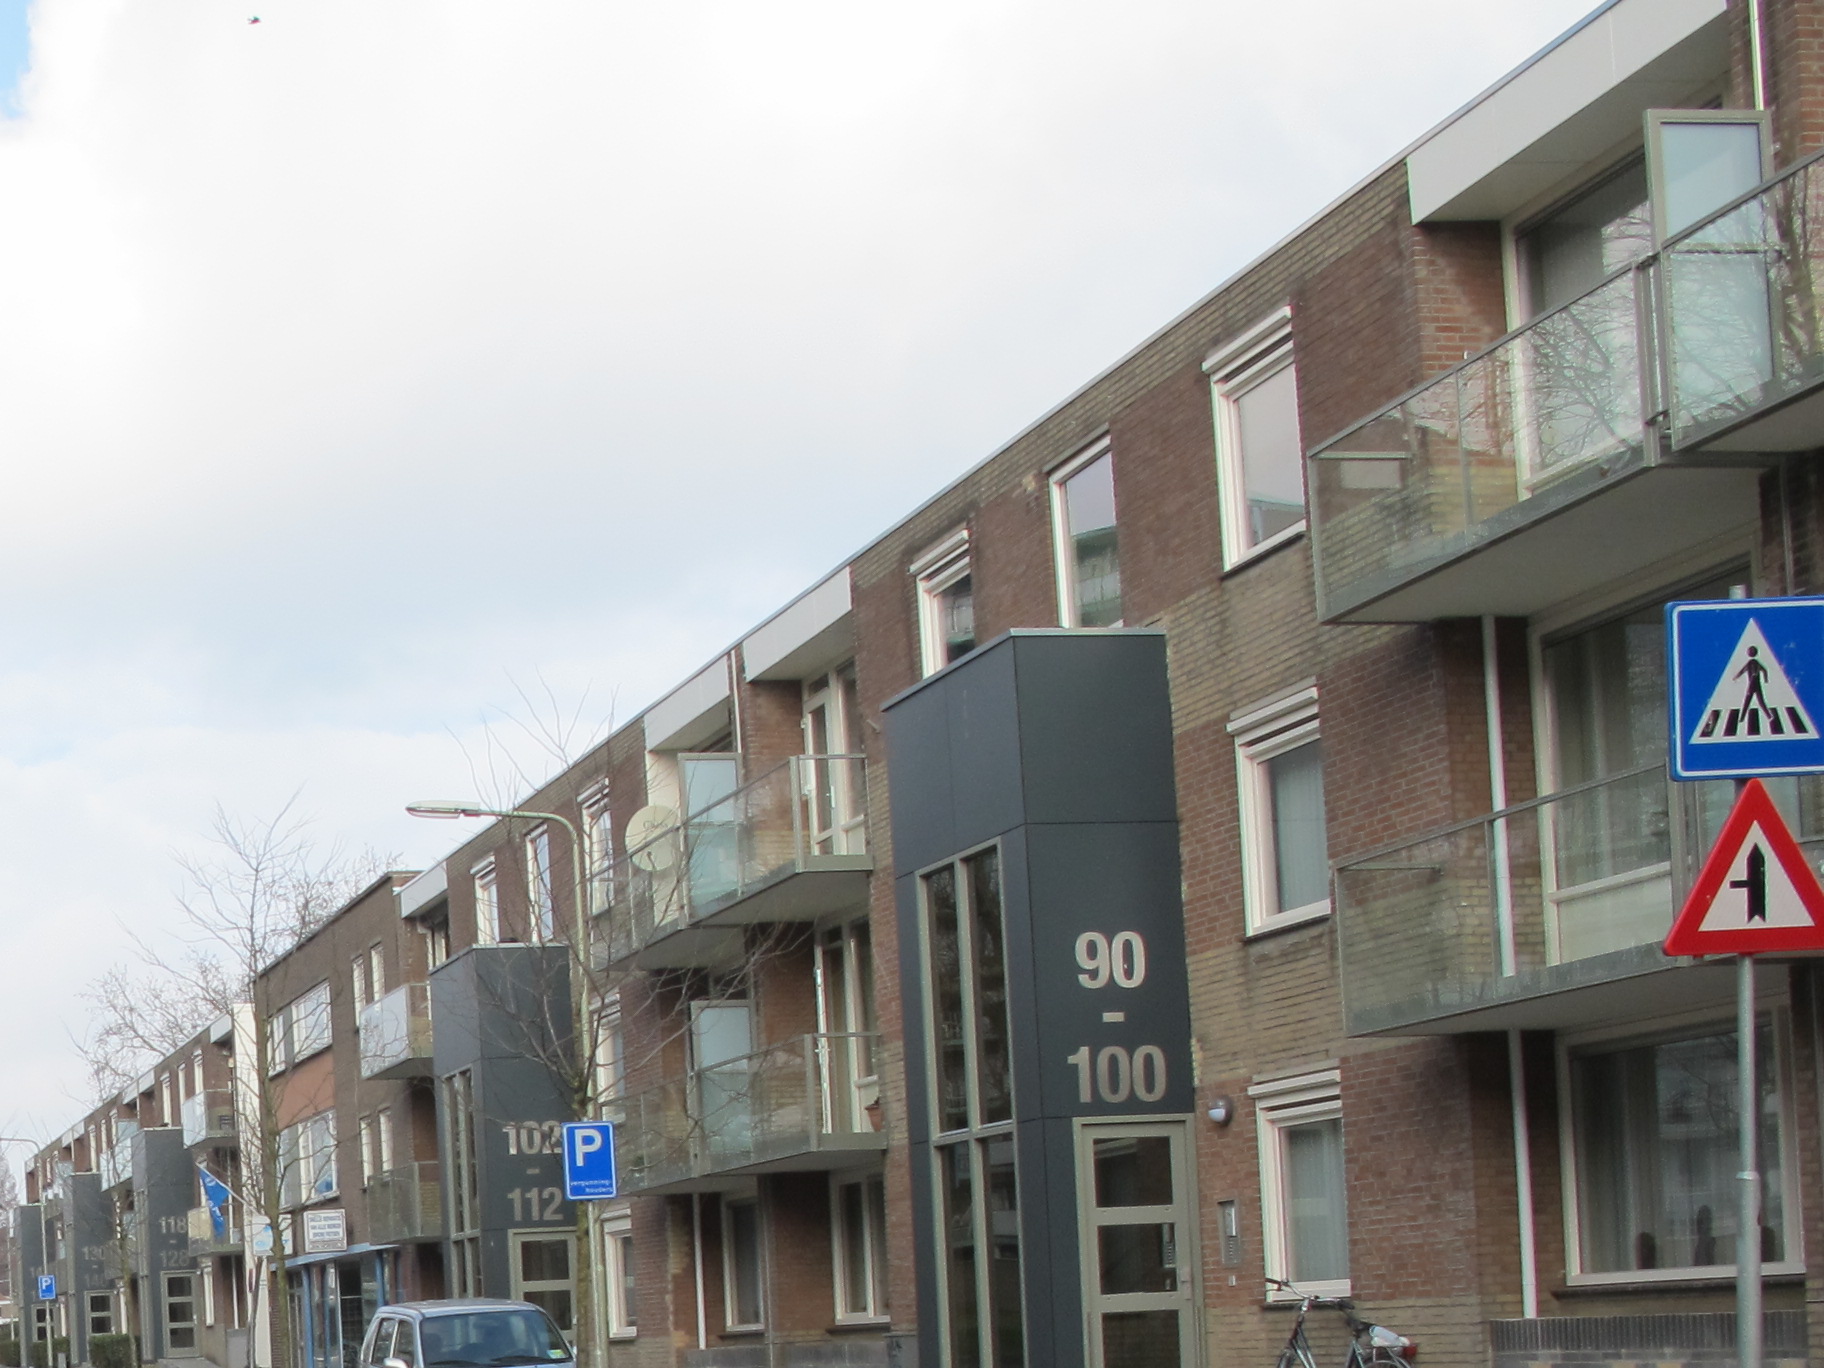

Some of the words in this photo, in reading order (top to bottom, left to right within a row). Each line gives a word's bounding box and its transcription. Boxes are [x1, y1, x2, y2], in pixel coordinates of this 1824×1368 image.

[1075, 931, 1146, 989] 90
[1067, 1045, 1166, 1103] 100
[502, 1120, 563, 1155] 102
[574, 1128, 603, 1167] P
[507, 1187, 564, 1221] 112
[158, 1216, 187, 1234] 118
